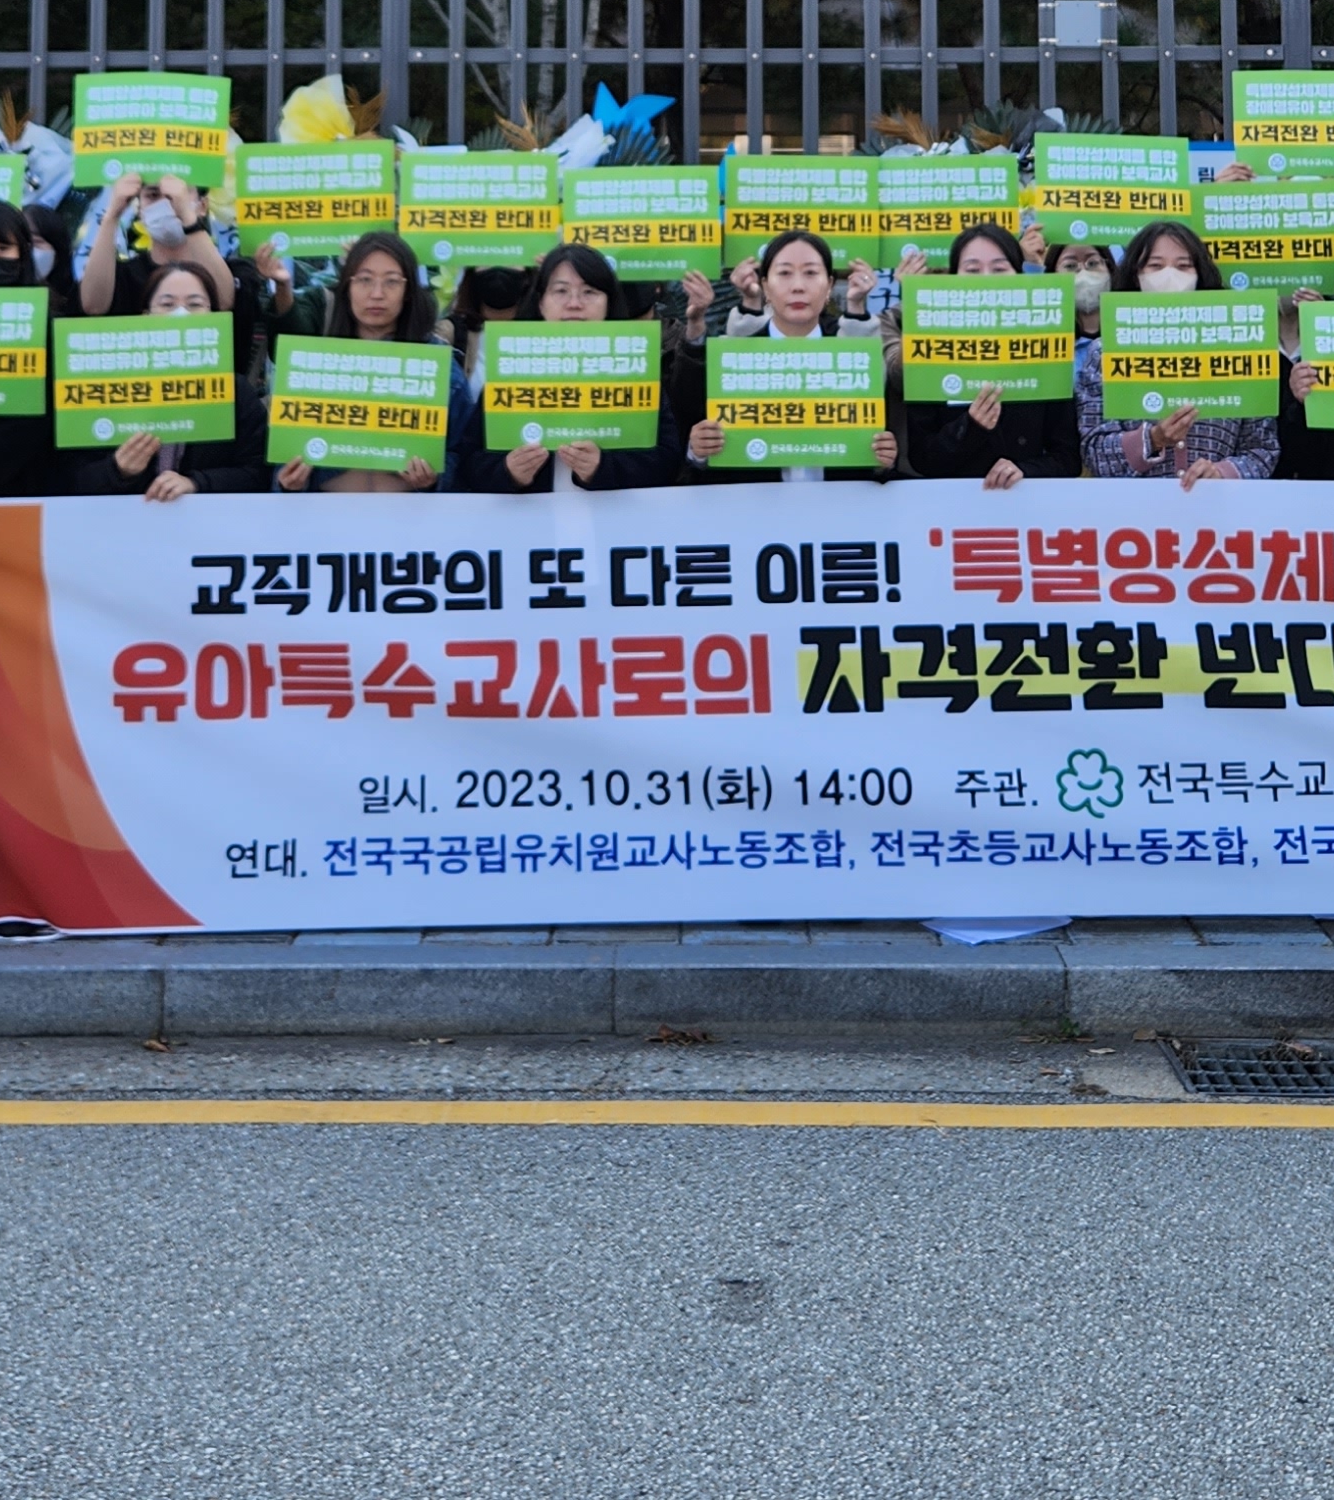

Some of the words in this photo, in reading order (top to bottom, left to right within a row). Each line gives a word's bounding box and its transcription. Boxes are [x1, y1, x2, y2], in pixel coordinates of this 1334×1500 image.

[82, 128, 156, 149] 자격전환
[1241, 124, 1318, 142] 자격전환
[243, 199, 323, 221] 자격전환
[1043, 189, 1122, 209] 자격전환
[408, 209, 487, 228] 자격전환
[732, 212, 810, 231] 자격전환
[571, 224, 651, 243] 자격전환
[911, 338, 1000, 361] 자격전환
[1111, 355, 1201, 379] 자격전환
[63, 380, 152, 406] 자격전환
[493, 386, 581, 408] 자격전환
[279, 400, 369, 426] 자격전환
[716, 402, 805, 425] 자격전환
[190, 549, 501, 615] 교직개방의
[529, 546, 586, 610] 또
[610, 544, 733, 608] 다른
[755, 540, 900, 605] 이름!
[112, 634, 771, 722] 유아특수교사로의
[800, 620, 1167, 715] 자격전환
[358, 774, 438, 813] 일시.
[455, 765, 772, 811] 2023.10.31(화)
[794, 768, 913, 807] 14:00
[956, 768, 1038, 808] 주관.
[224, 841, 308, 879] 연대.
[322, 830, 855, 875] 전국국공립유치원교사노동조합,
[870, 825, 1258, 869] 전국초등교사노동조합,
